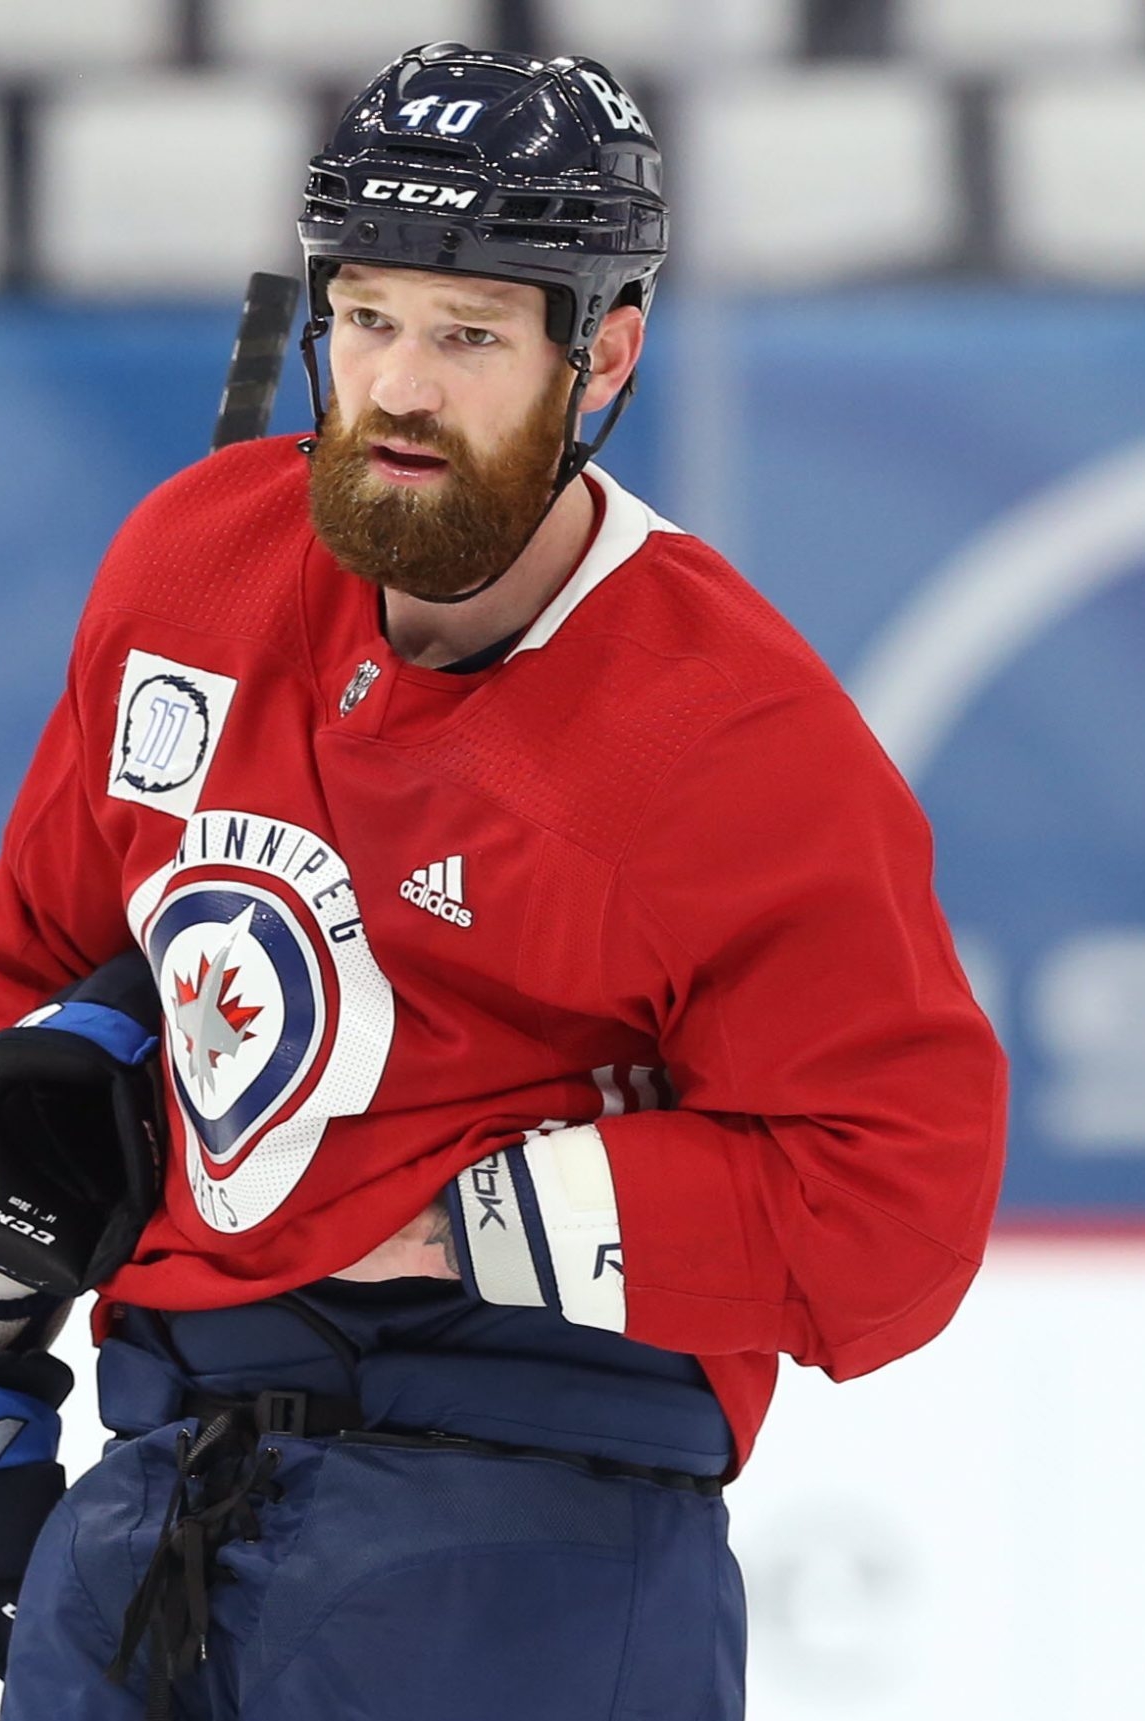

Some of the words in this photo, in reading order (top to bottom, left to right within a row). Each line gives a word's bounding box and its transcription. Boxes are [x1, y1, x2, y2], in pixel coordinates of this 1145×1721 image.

[398, 95, 483, 135] 40
[361, 179, 478, 209] CCM
[135, 697, 189, 771] 11
[399, 880, 473, 928] adidas
